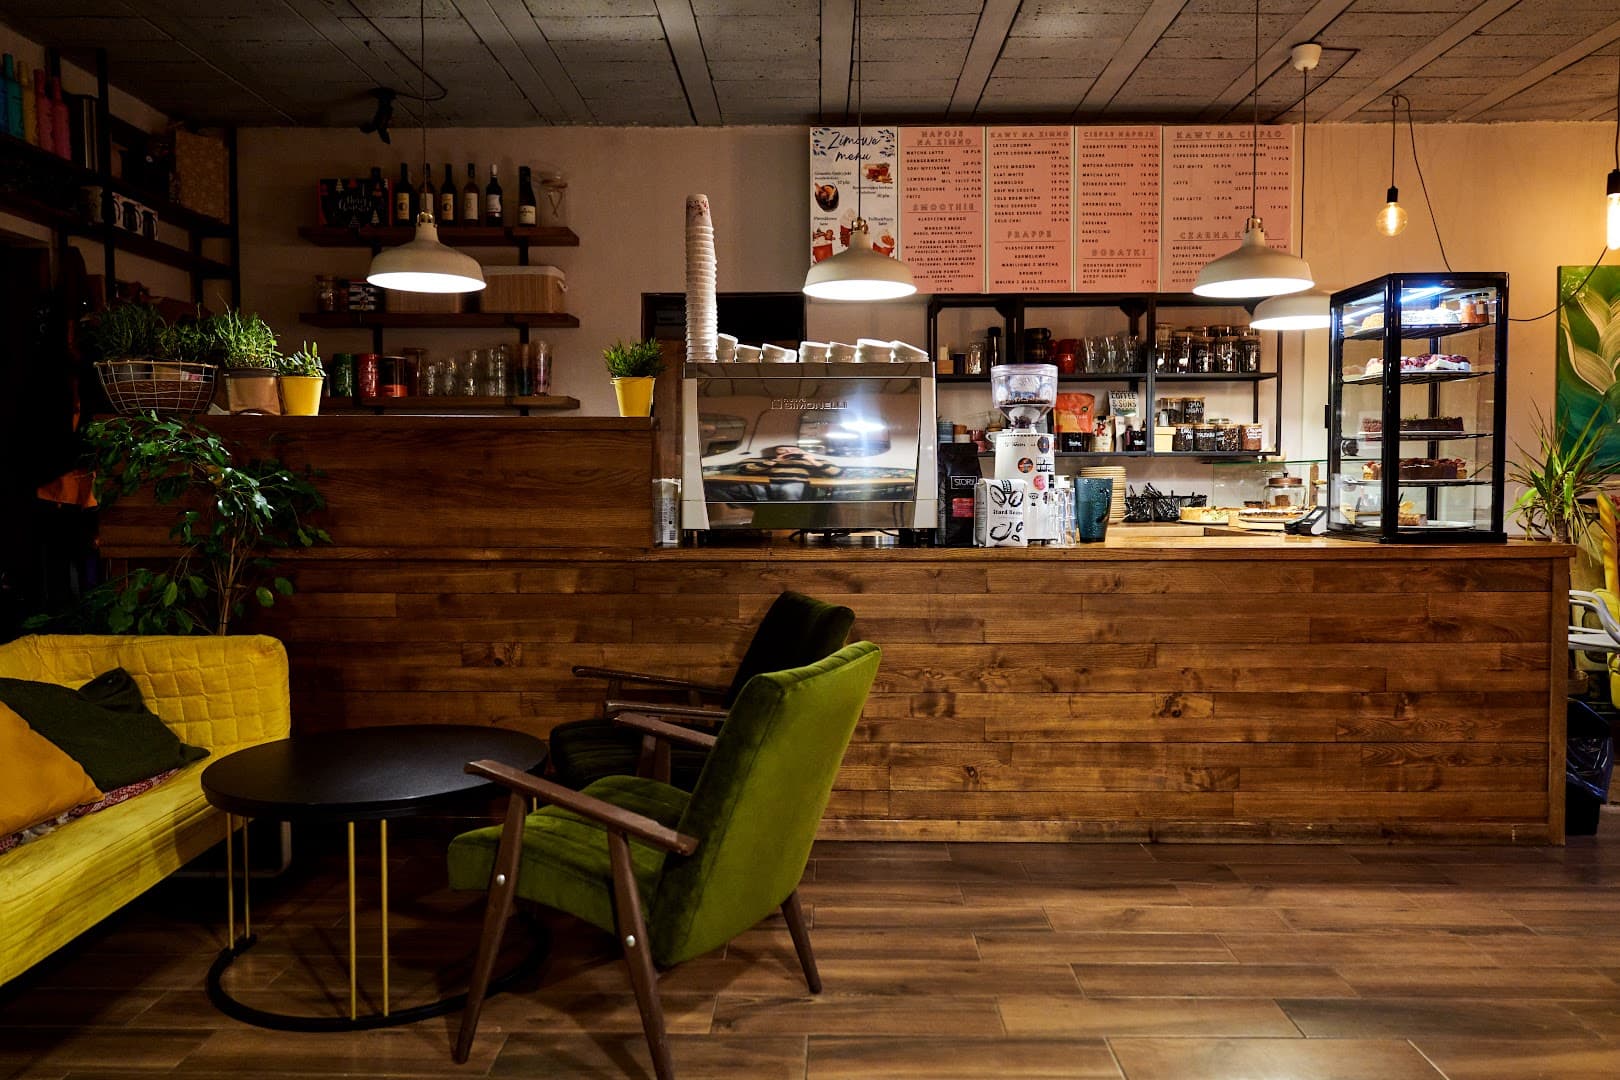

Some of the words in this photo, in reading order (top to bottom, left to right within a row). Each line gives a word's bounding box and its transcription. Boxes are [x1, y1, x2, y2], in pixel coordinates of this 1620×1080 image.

[921, 130, 964, 138] NAPOJE
[990, 131, 1018, 139] KAWY
[1038, 130, 1069, 138] ZIMNO
[1118, 130, 1154, 138] NAPOJE
[1176, 130, 1212, 139] KAWY
[1217, 130, 1233, 139] NA
[827, 131, 881, 150] Zimowe
[936, 138, 972, 146] ZIMNO
[834, 151, 872, 162] menu
[912, 203, 974, 211] SMOOTHIE
[1007, 230, 1052, 239] FRAPPE
[1179, 231, 1230, 240] CZARNA
[1091, 248, 1146, 257] DODATKI
[1111, 392, 1137, 400] COFFEE
[784, 402, 849, 410] SIMONELLI
[1118, 399, 1137, 408] SONS
[953, 478, 975, 486] STORY
